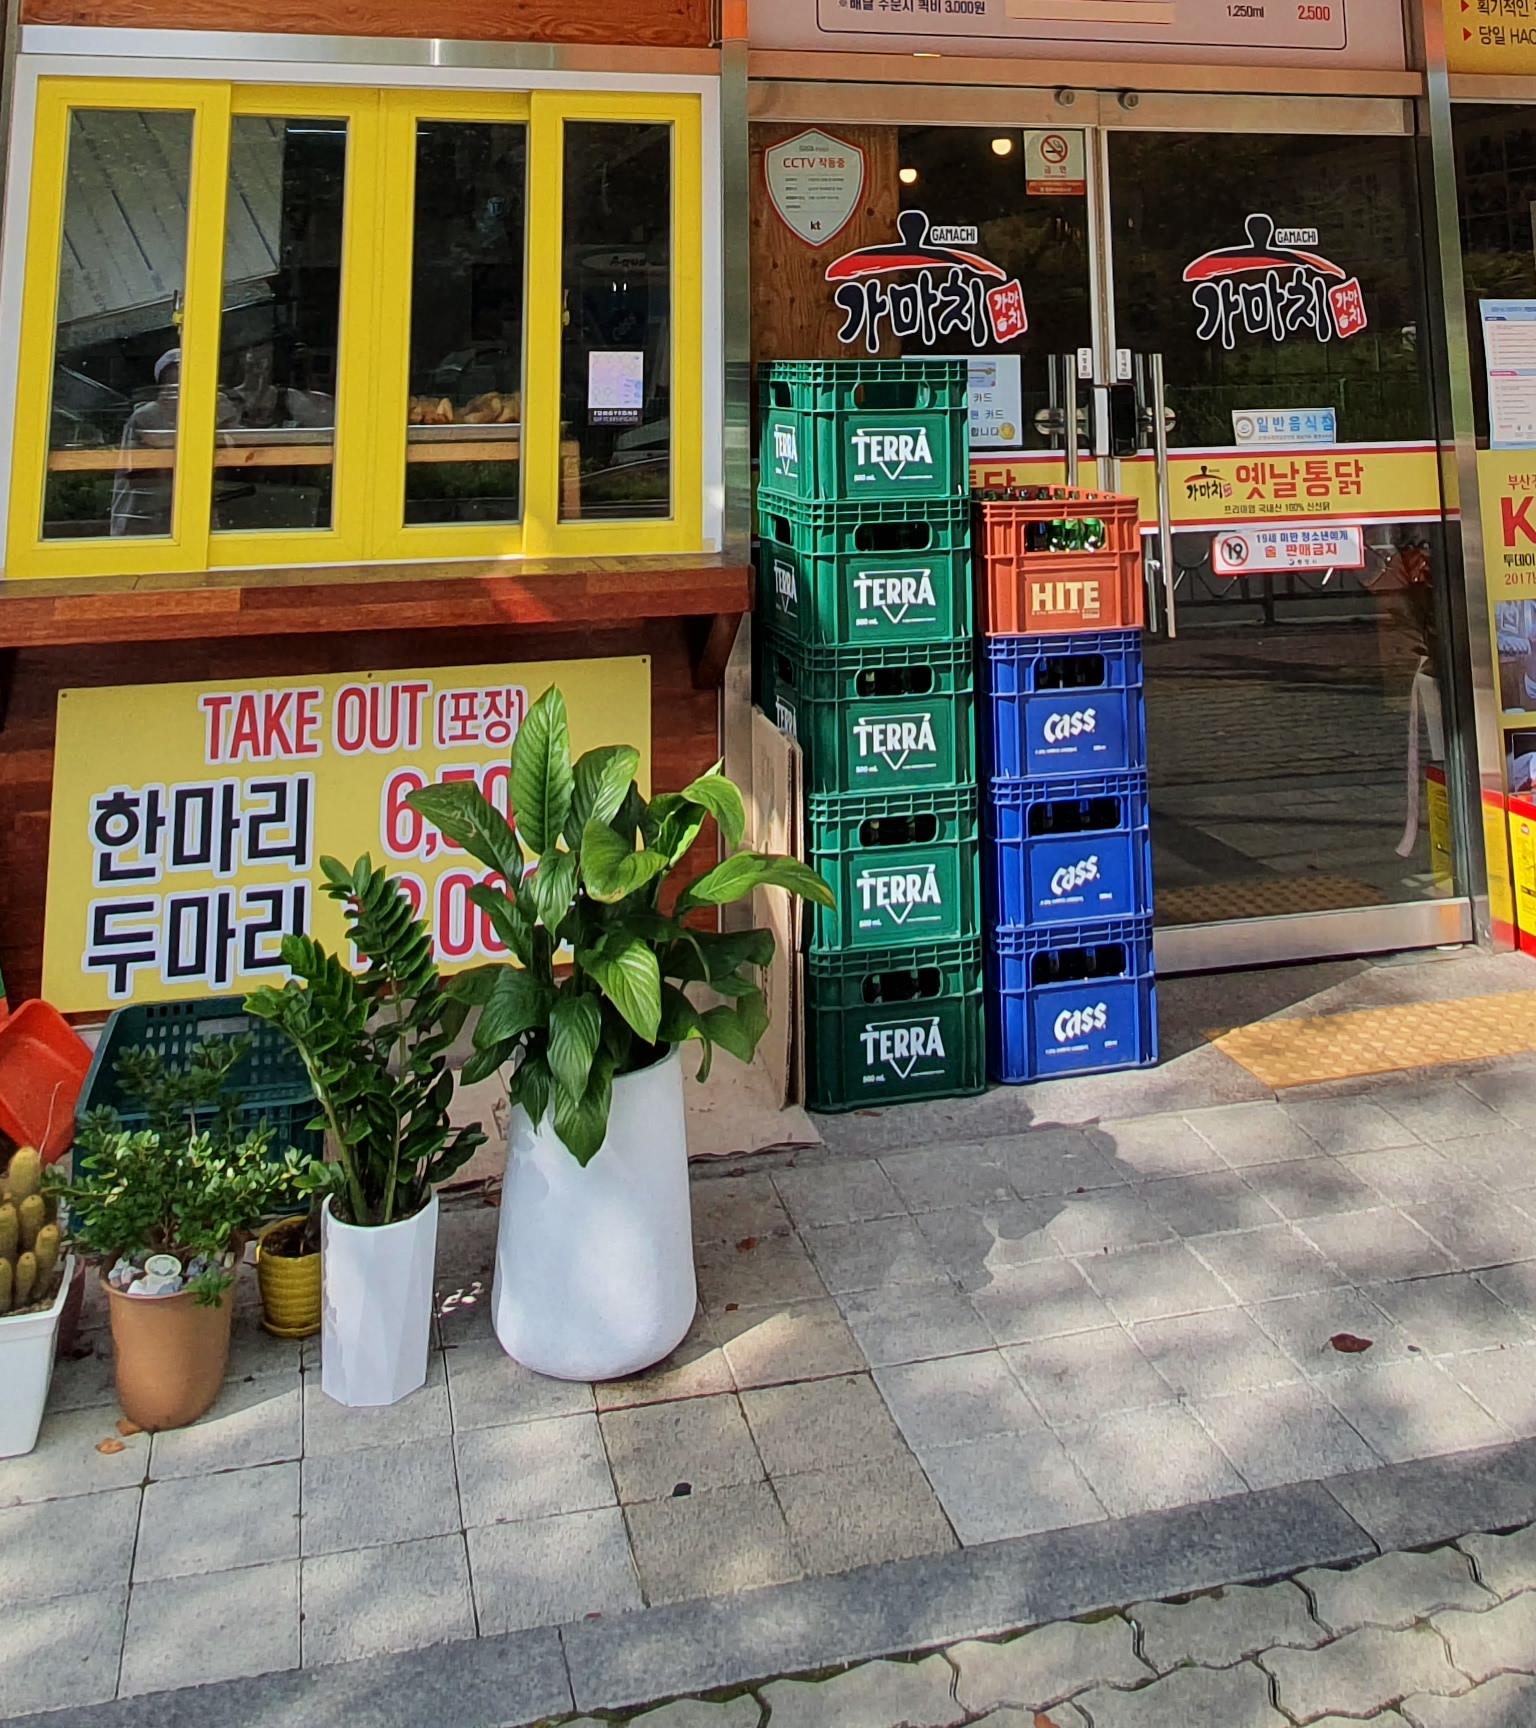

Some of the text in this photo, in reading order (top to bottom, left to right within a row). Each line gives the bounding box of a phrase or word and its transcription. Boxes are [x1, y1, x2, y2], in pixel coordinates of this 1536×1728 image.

[1298, 5, 1330, 21] 2,500
[1479, 25, 1505, 45] 당일
[783, 158, 815, 168] CCTV
[810, 221, 821, 231] kt
[932, 228, 975, 242] GAMACHI
[1277, 228, 1318, 245] GAMACHI
[836, 268, 987, 354] 가마치
[1193, 268, 1330, 350] 가마치
[1256, 416, 1334, 433] 일반음식점
[774, 430, 797, 463] TERRA
[851, 433, 933, 465] TERRA
[1187, 460, 1364, 501] 가마치 옛날통닭
[1286, 543, 1337, 556] 판매금지
[1503, 553, 1535, 567] 투데이
[853, 575, 936, 610] TERRA
[1032, 581, 1100, 611] HITE
[201, 684, 525, 761] TAKE OUT (포장)
[853, 719, 936, 756] TERRA
[95, 777, 310, 882] 한마리
[856, 870, 942, 911] TERRA
[86, 885, 306, 993] 두마리
[860, 1023, 945, 1066] TERRA
